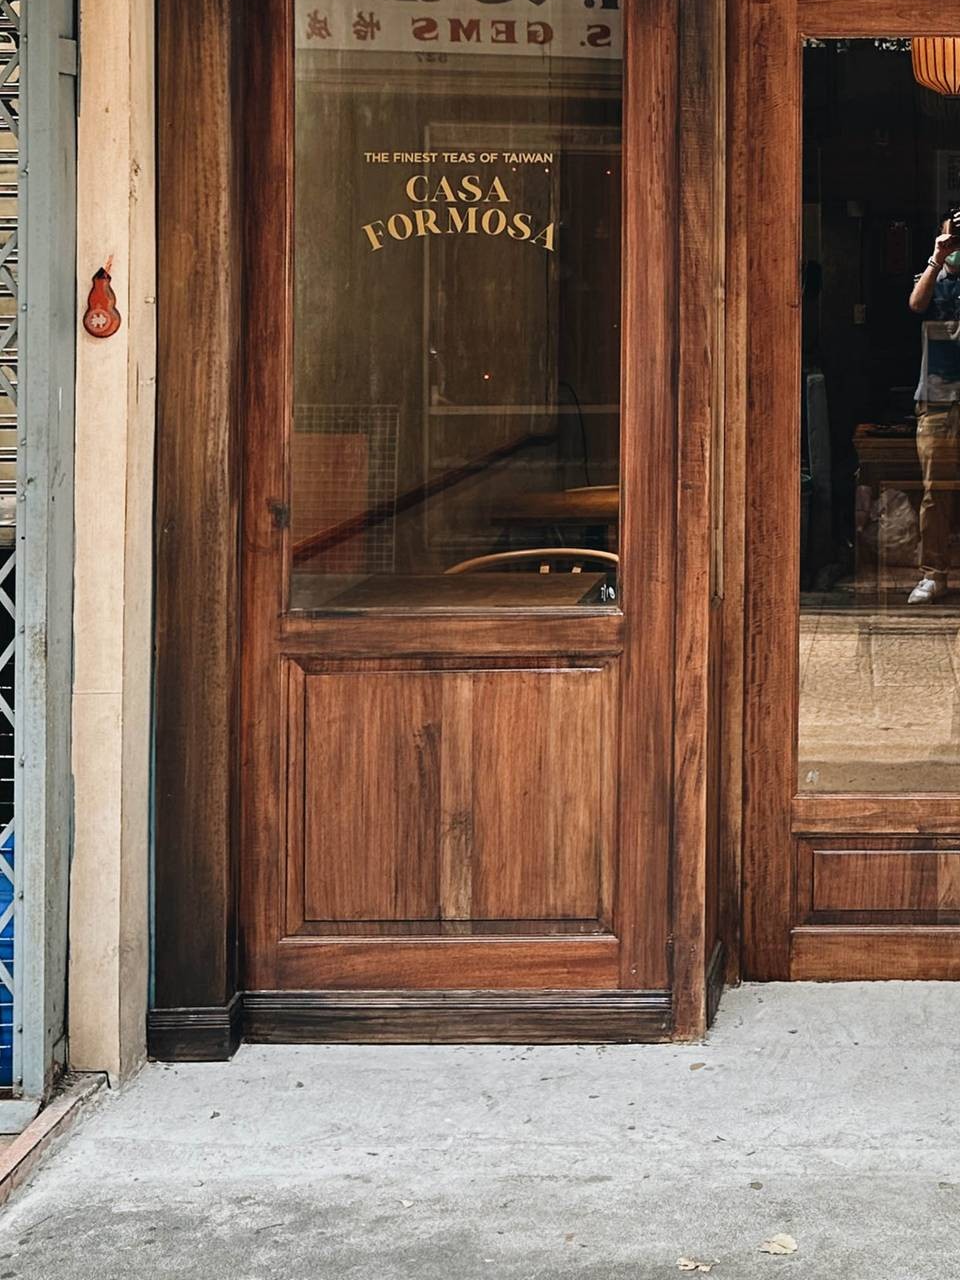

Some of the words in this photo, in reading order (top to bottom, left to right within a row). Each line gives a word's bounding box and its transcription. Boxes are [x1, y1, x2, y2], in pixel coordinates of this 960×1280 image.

[364, 152, 389, 163] THE
[393, 152, 438, 163] FINEST
[442, 152, 476, 163] TEAS
[480, 152, 498, 163] OF
[502, 152, 553, 164] TAIWAN
[406, 175, 510, 203] CASA
[361, 206, 555, 252] FORMOSA
